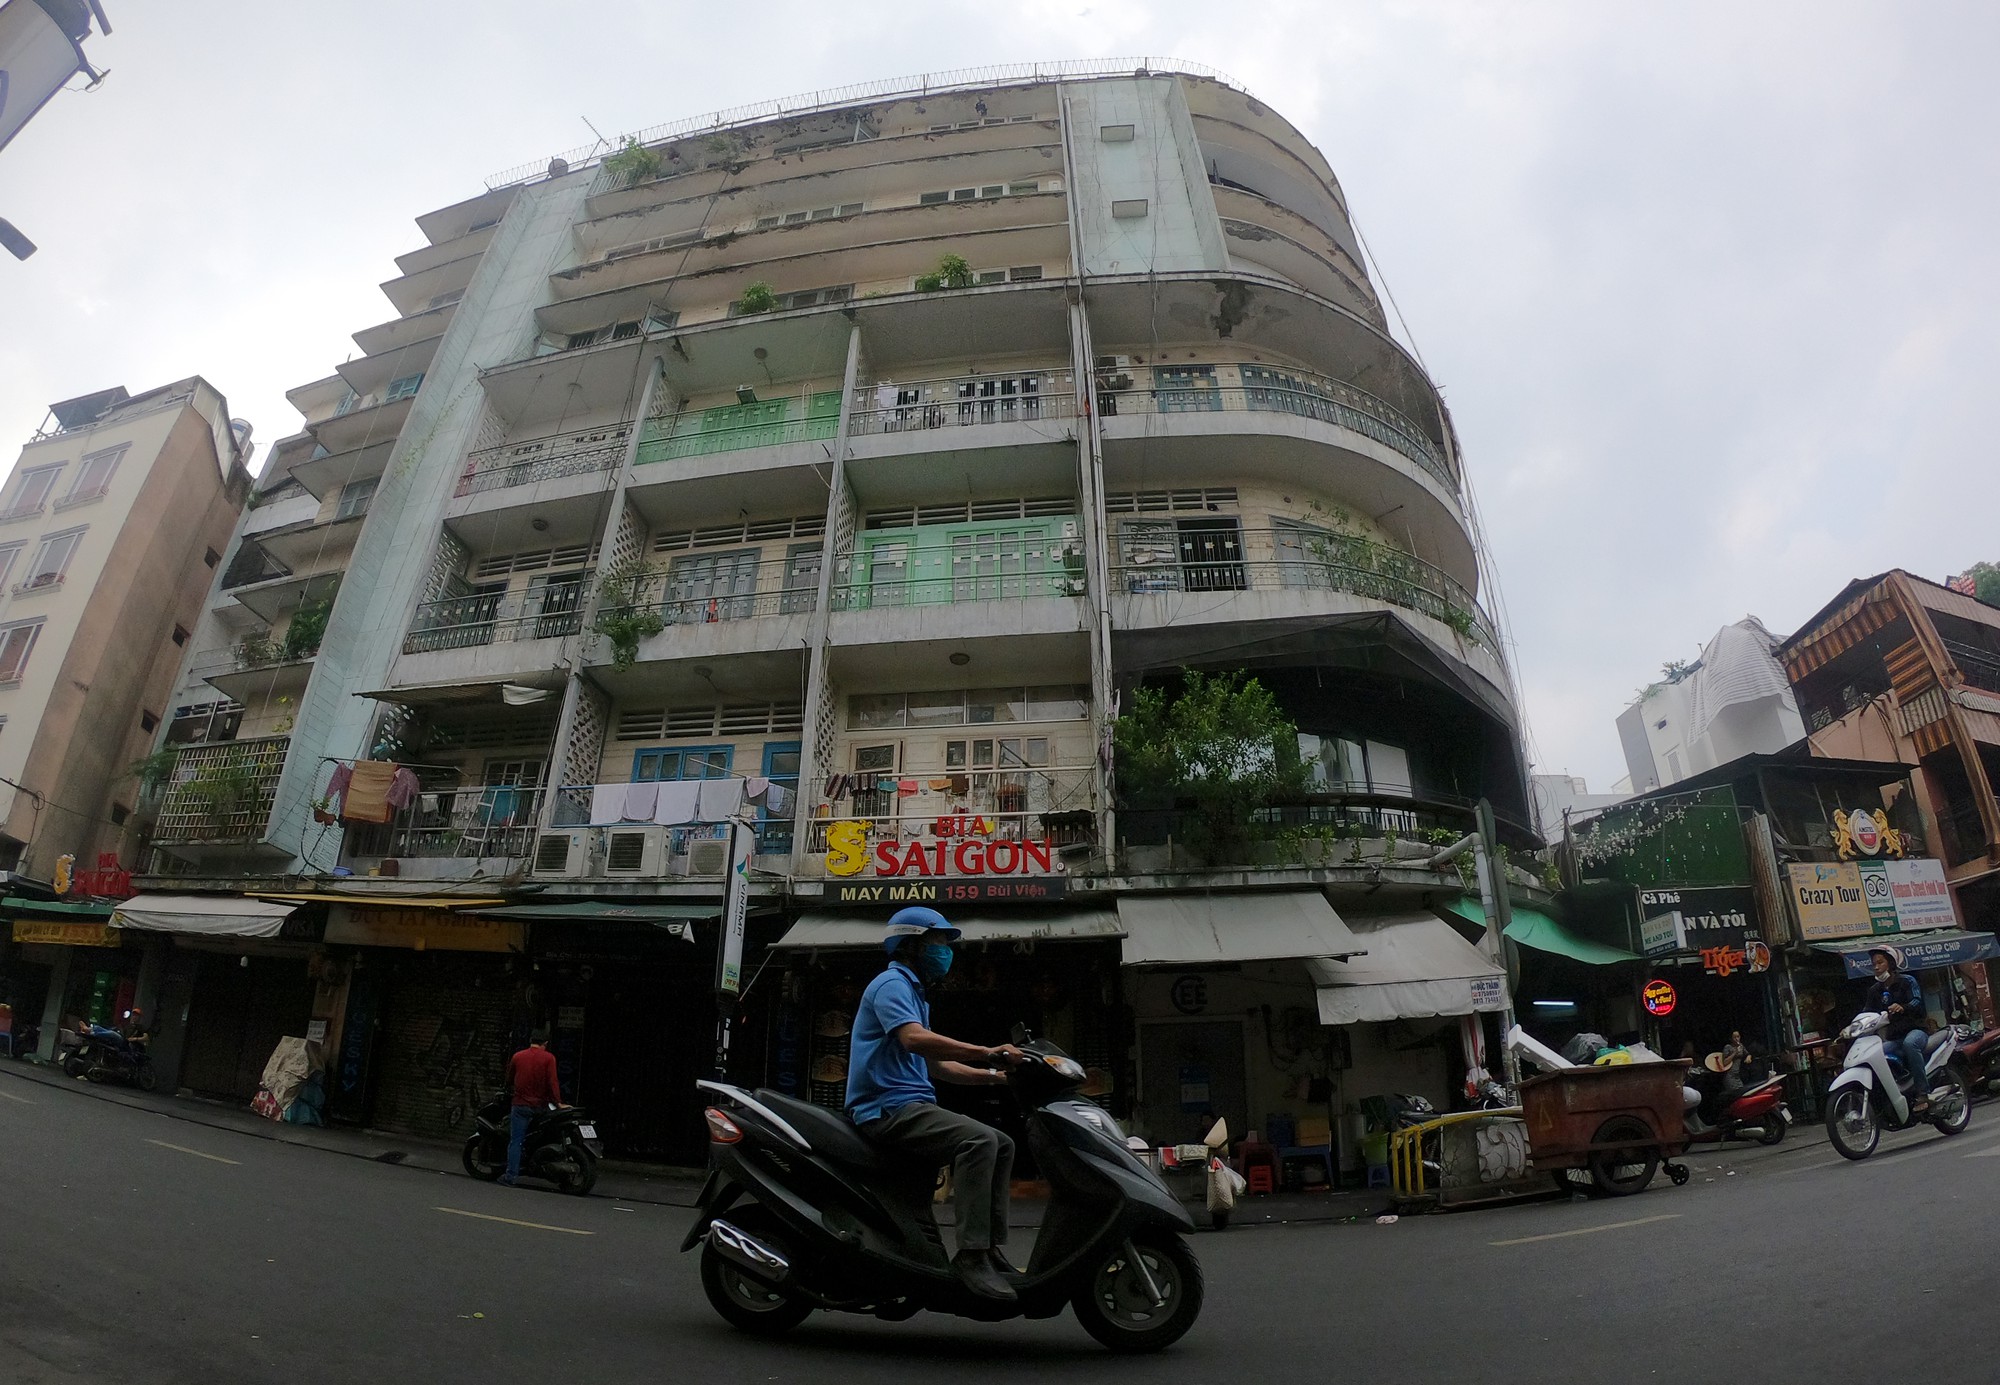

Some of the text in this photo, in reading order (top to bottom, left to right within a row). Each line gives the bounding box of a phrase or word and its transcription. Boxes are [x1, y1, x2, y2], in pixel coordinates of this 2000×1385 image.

[936, 815, 988, 838] BIA
[875, 837, 1051, 876] SAIGON
[840, 886, 884, 901] MAY
[889, 881, 936, 900] MẮN
[945, 884, 980, 899] 159
[987, 884, 1011, 897] Bùi
[1641, 891, 1681, 905] Cà Phê
[1799, 885, 1860, 906] Crazy Tour
[1698, 910, 1721, 929] VÀ
[1721, 908, 1747, 928] TÔI
[1905, 941, 1961, 957] CAFE CHIP CHIP
[1699, 945, 1746, 977] Tiger
